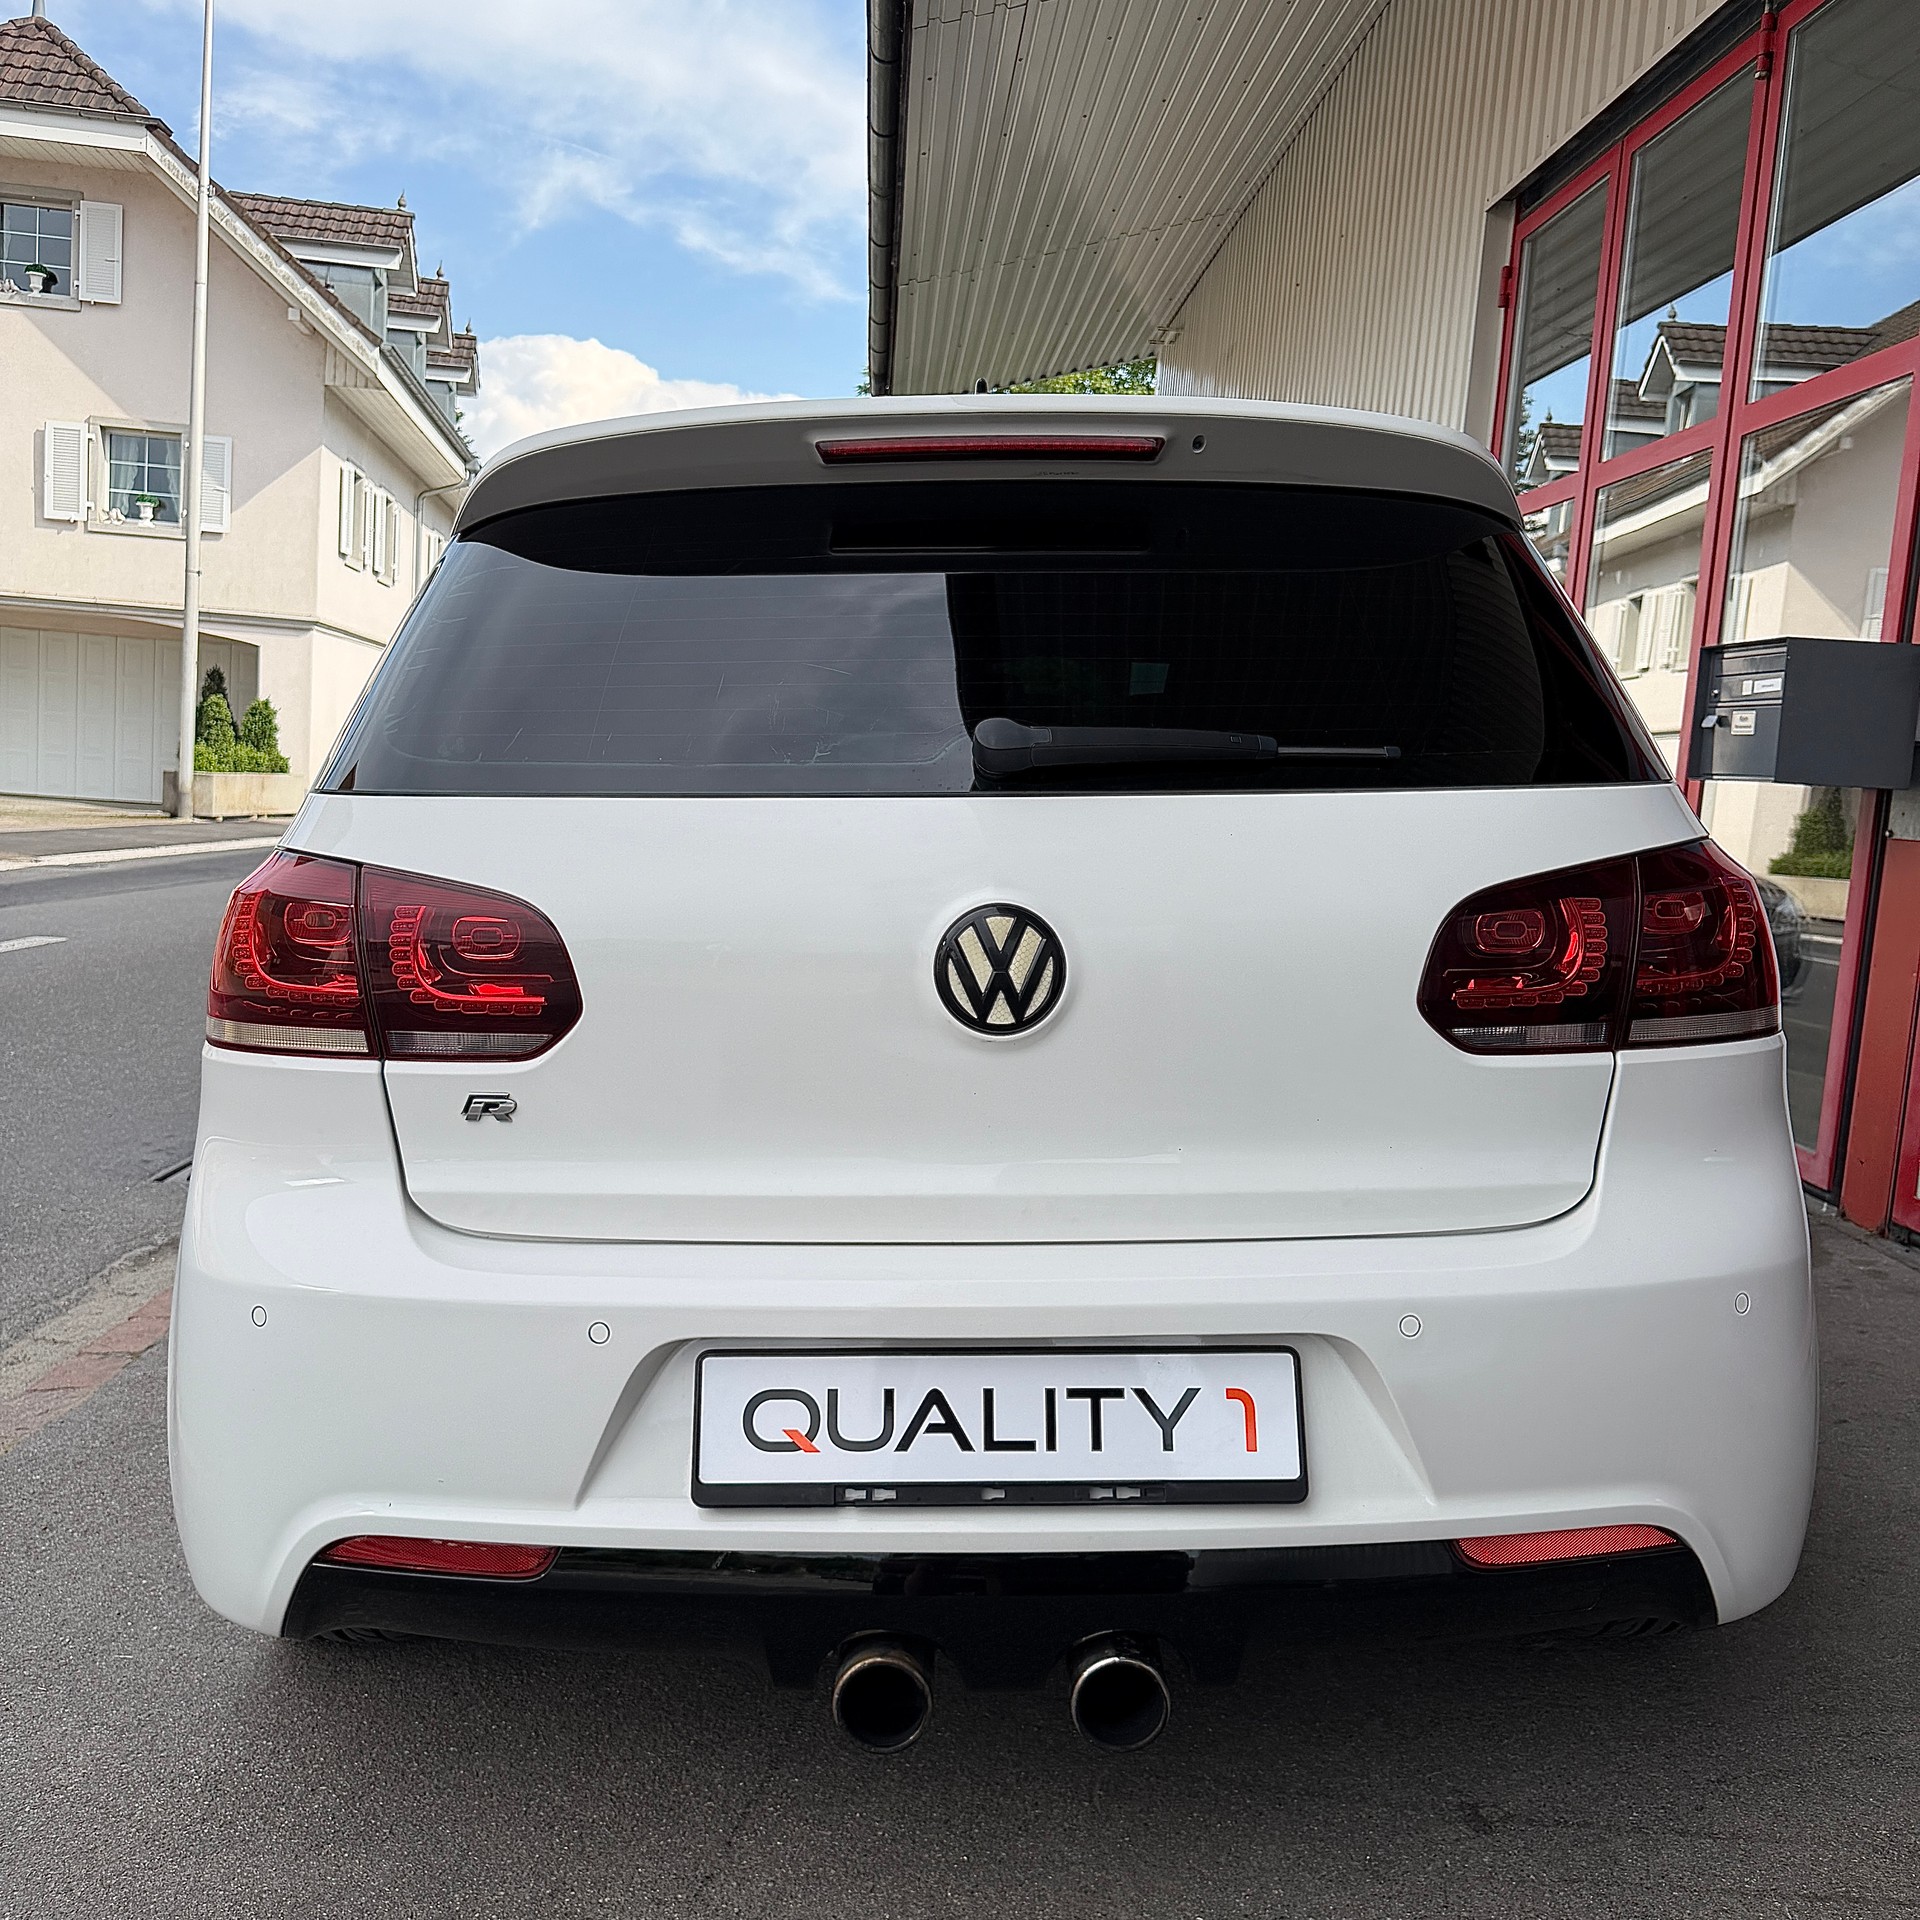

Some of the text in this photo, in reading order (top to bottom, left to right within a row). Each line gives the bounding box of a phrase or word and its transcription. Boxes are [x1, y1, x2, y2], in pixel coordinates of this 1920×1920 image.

[934, 903, 1067, 1036] VW
[461, 1092, 517, 1122] R
[742, 1387, 1258, 1453] QUALITY 1
